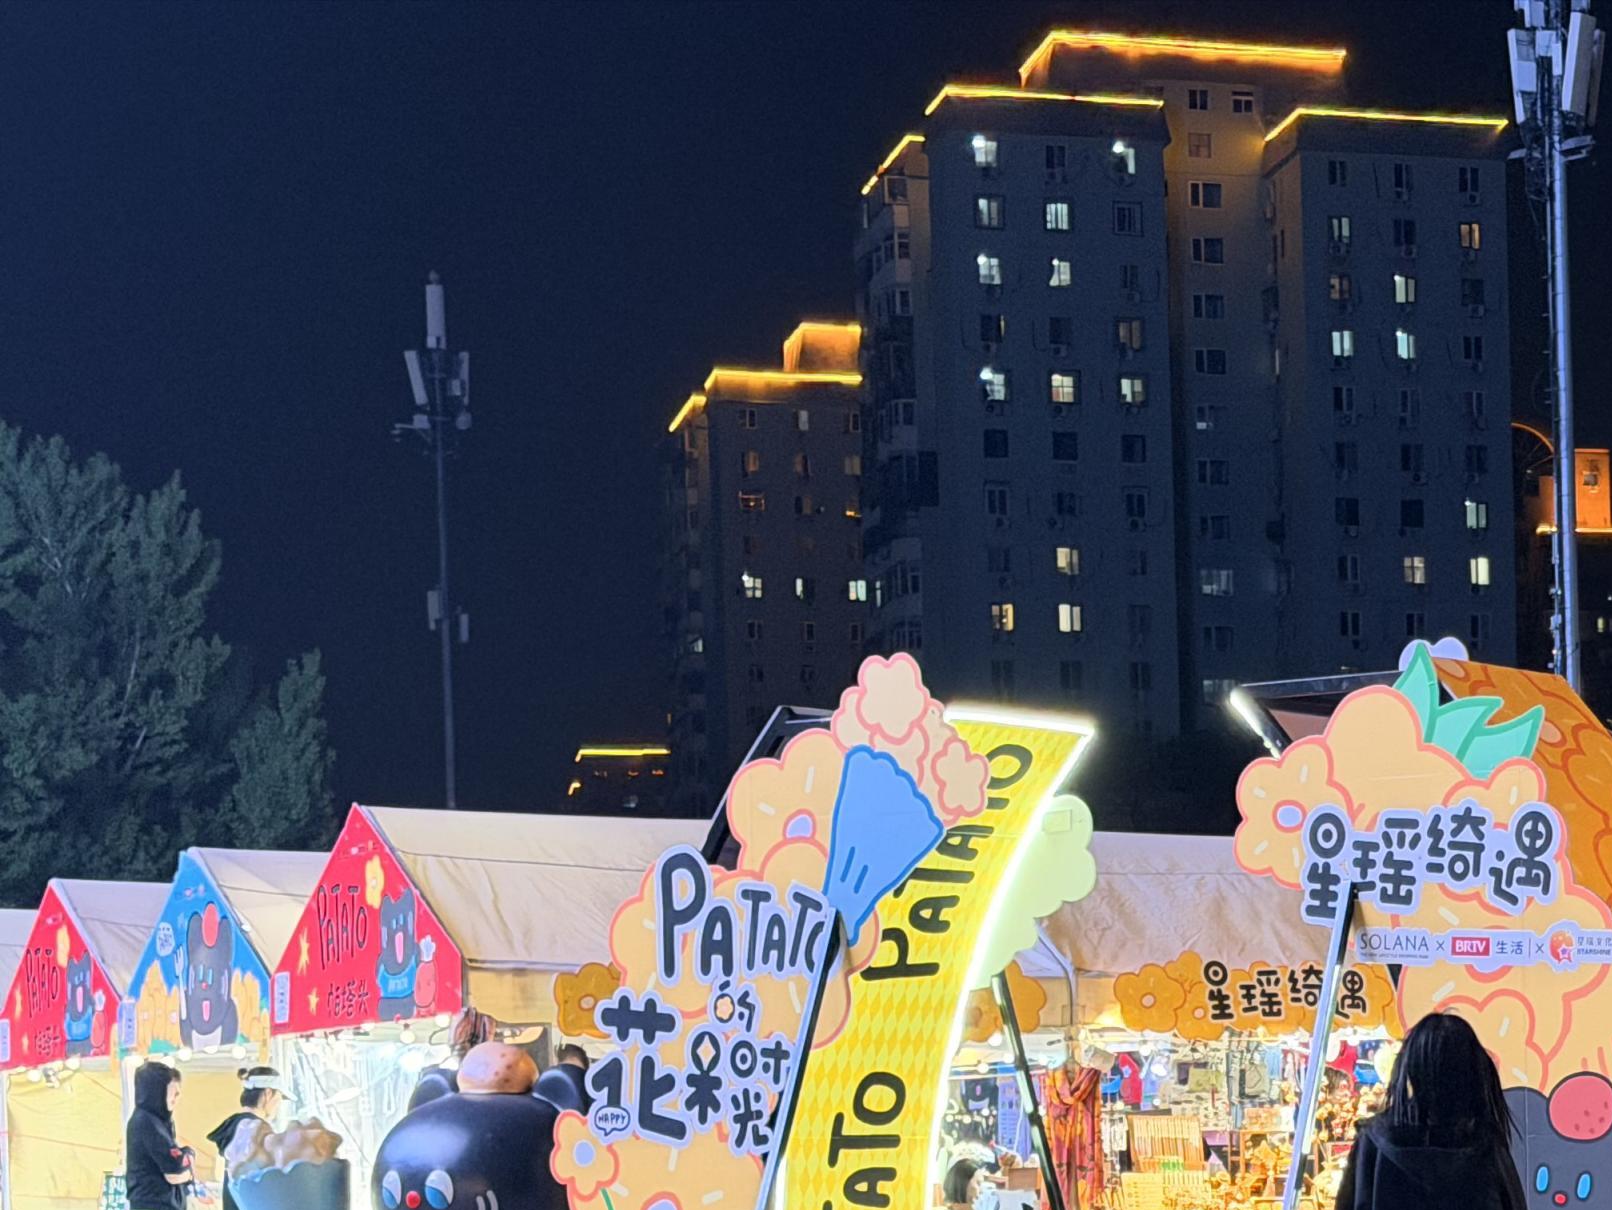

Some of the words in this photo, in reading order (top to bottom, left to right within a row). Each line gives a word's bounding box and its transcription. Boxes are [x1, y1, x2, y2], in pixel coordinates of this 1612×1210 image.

[860, 744, 1034, 981] PATAO
[317, 884, 367, 970] PATATO
[1360, 933, 1429, 951] SOLANA
[1455, 939, 1486, 953] BRTV
[1496, 940, 1523, 955] 生活
[598, 1112, 627, 1125] HAPPY
